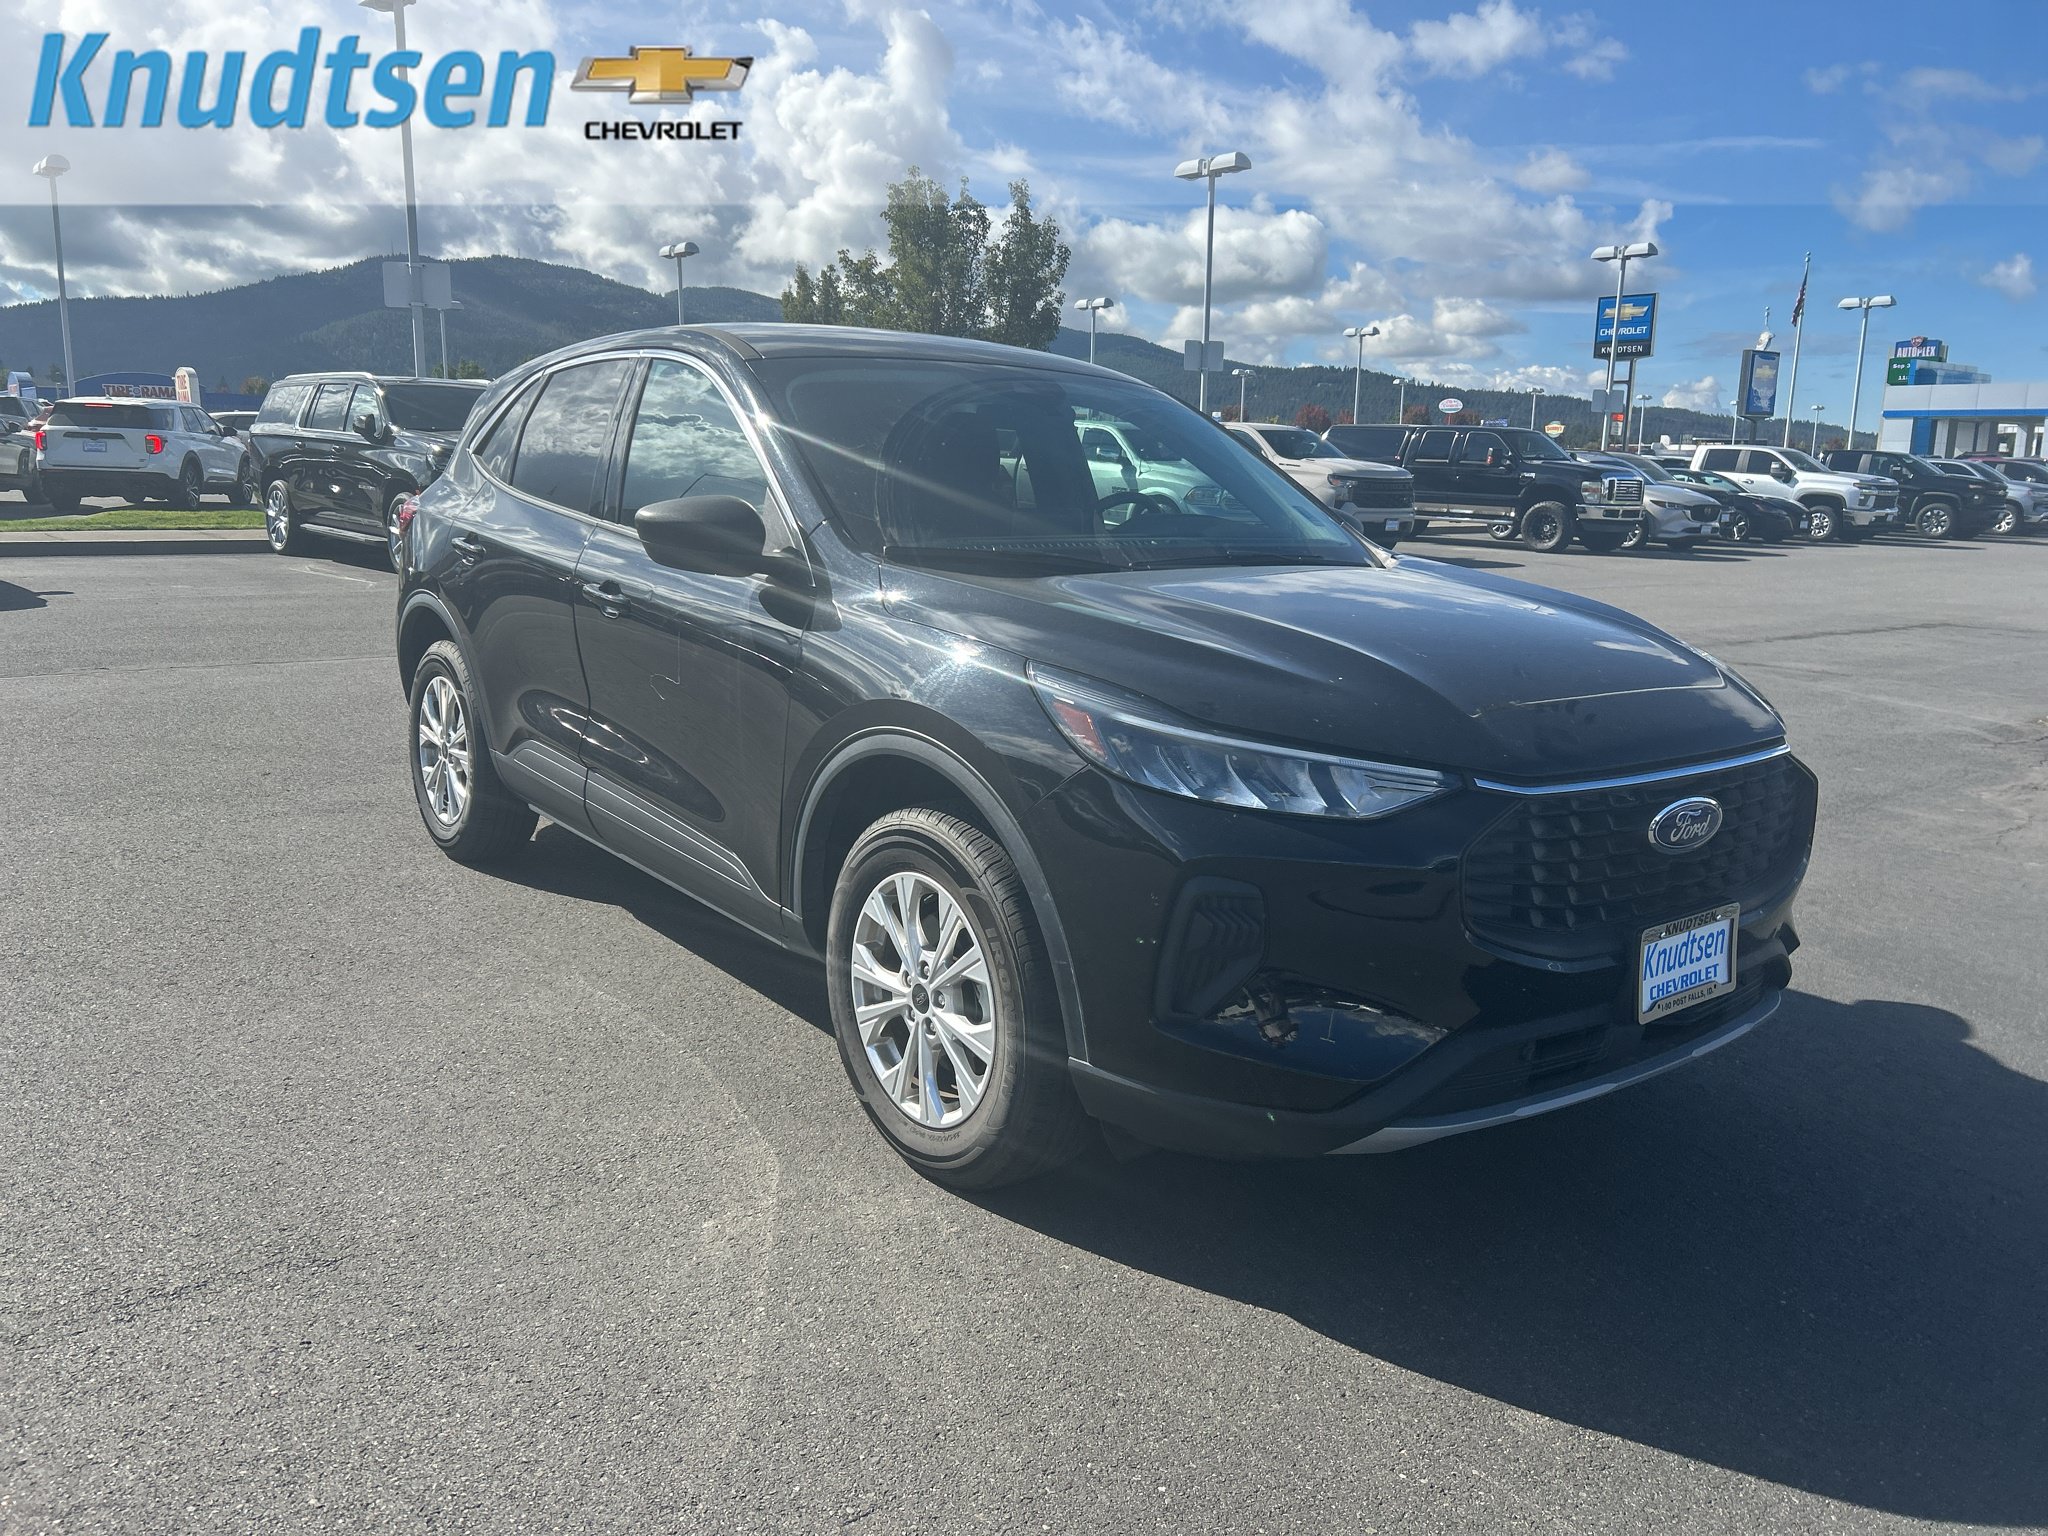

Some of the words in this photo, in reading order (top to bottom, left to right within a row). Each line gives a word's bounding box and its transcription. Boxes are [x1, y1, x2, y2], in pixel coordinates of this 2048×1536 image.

[1601, 345, 1643, 354] KNDTSEN
[1897, 346, 1936, 357] AUTOPLEX
[104, 385, 132, 397] TIRE
[142, 387, 176, 398] RAMA
[1670, 809, 1711, 842] Ford
[1665, 910, 1717, 935] KNUDTSEN
[1643, 928, 1726, 981] Knudtsen
[1649, 963, 1719, 1001] CHEVROLET
[1672, 995, 1687, 1007] POST
